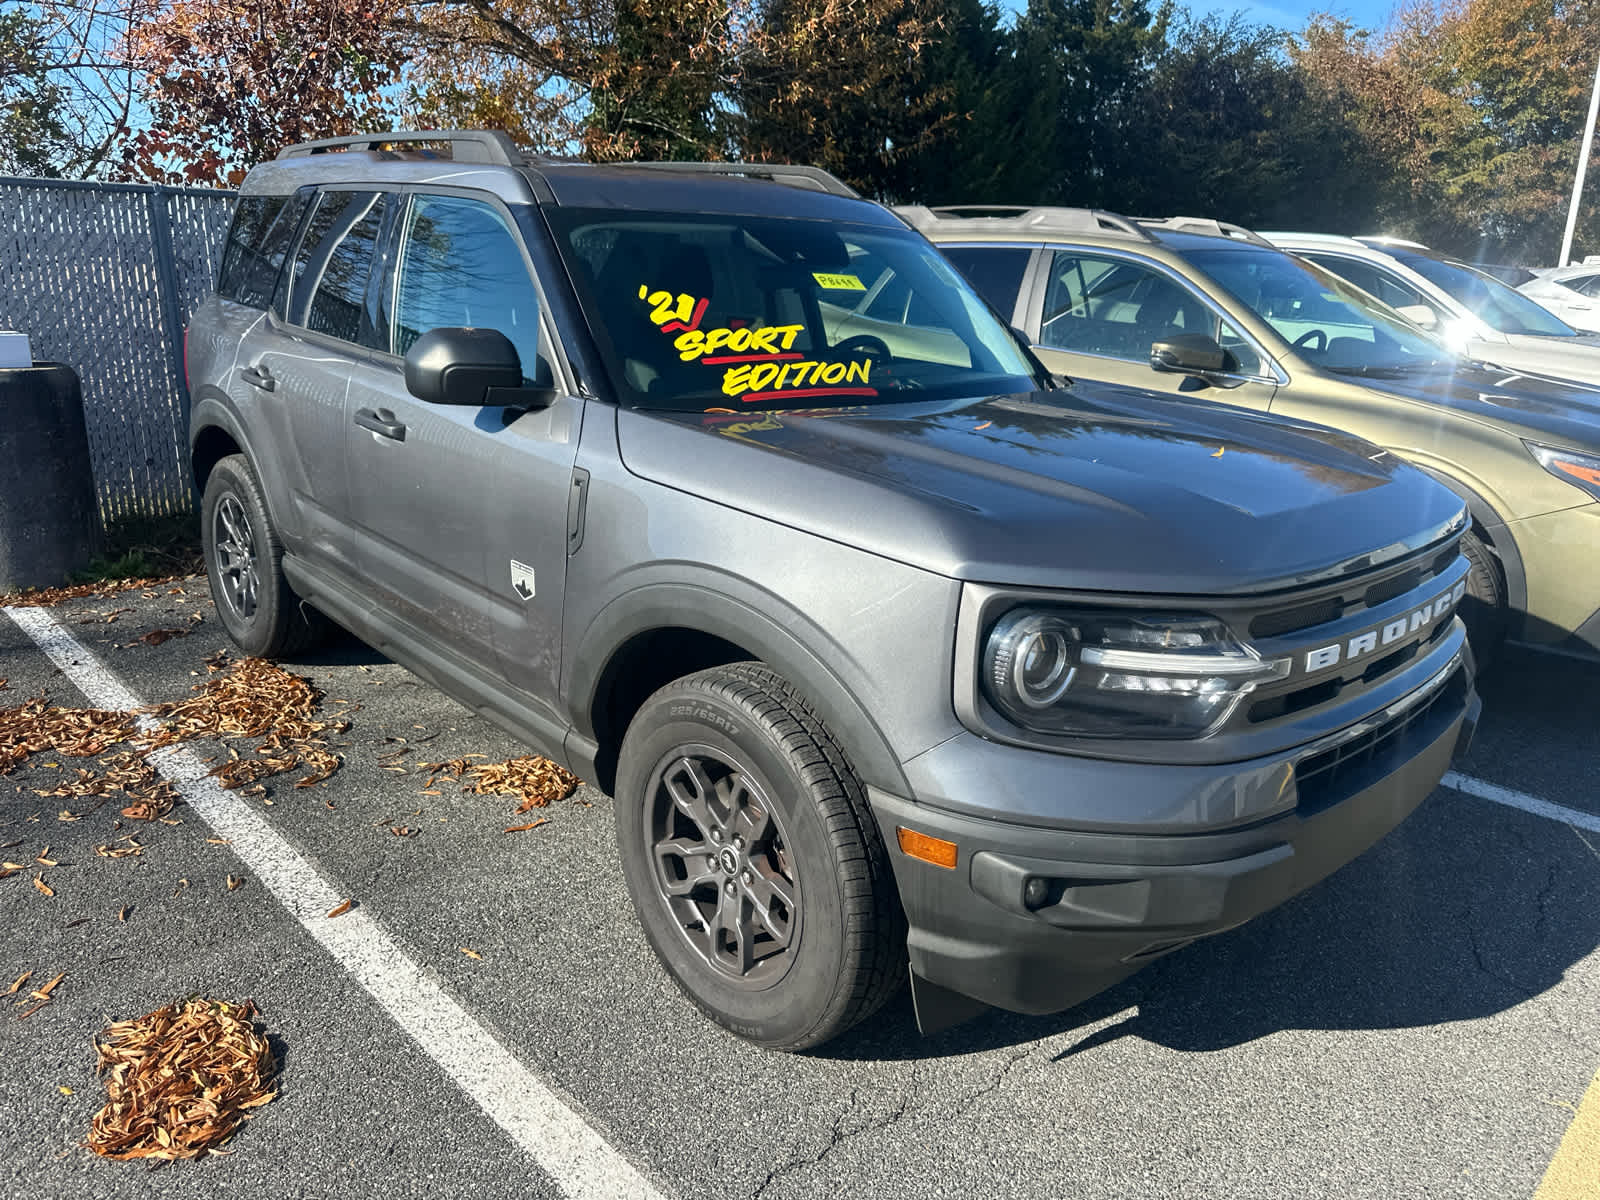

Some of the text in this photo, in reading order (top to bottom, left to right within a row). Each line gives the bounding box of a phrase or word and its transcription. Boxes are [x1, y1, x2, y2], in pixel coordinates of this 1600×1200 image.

[673, 324, 805, 361] SPORT
[722, 358, 872, 397] EDITION
[671, 705, 740, 735] 225/65R17
